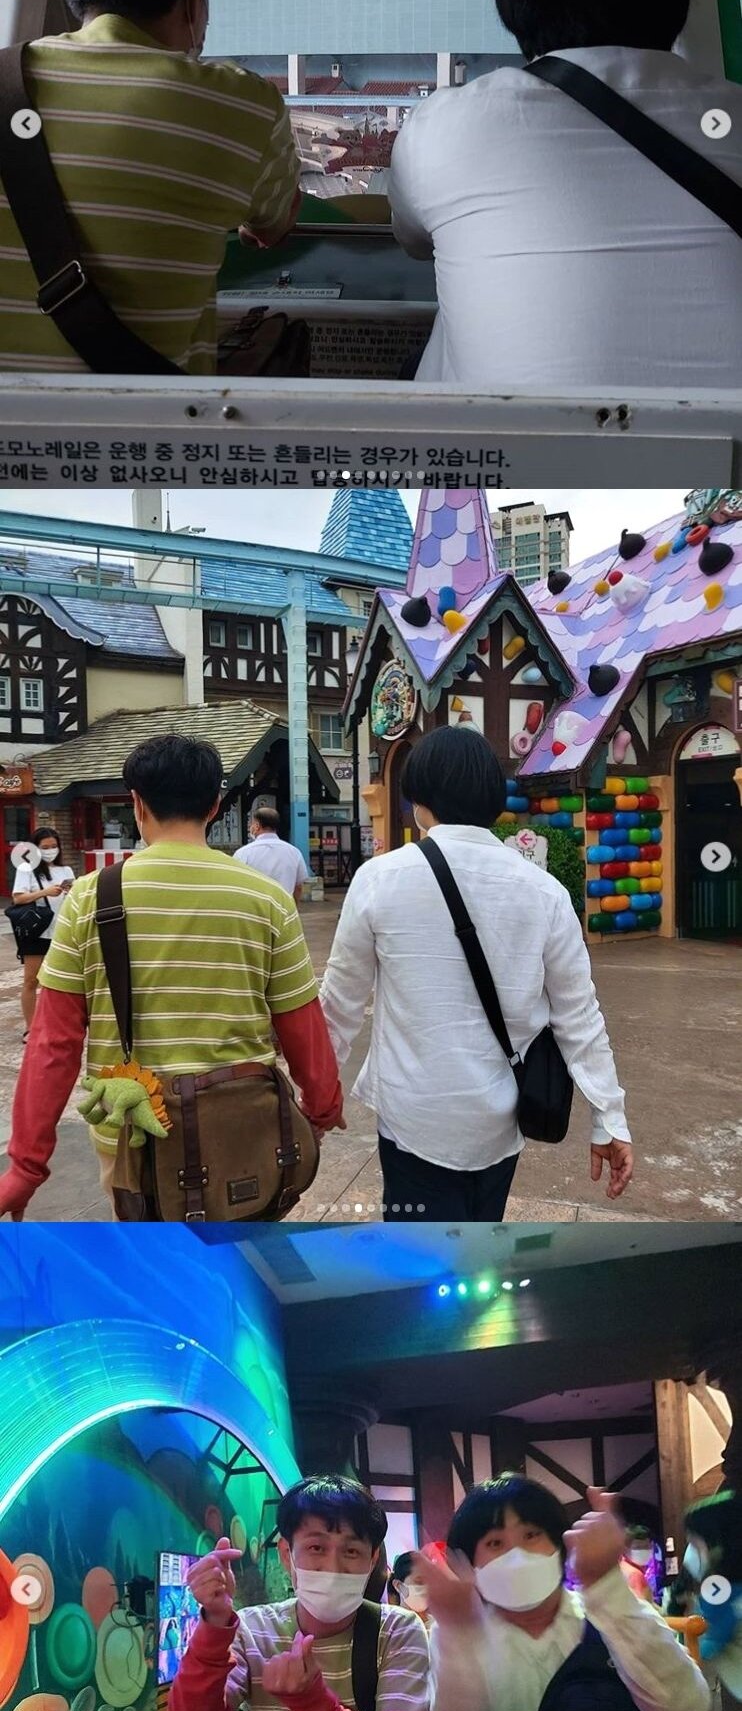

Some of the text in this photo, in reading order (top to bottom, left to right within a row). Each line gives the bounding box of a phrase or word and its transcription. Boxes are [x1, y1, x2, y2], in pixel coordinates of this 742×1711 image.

[0, 441, 511, 468] 모노레일은 운행 중 정지 또는 흔들리는 경우가 있습니다.
[60, 464, 98, 483] 이상
[109, 465, 188, 484] 없사오니
[199, 467, 298, 486] 안심하시고
[701, 732, 720, 745] 출구
